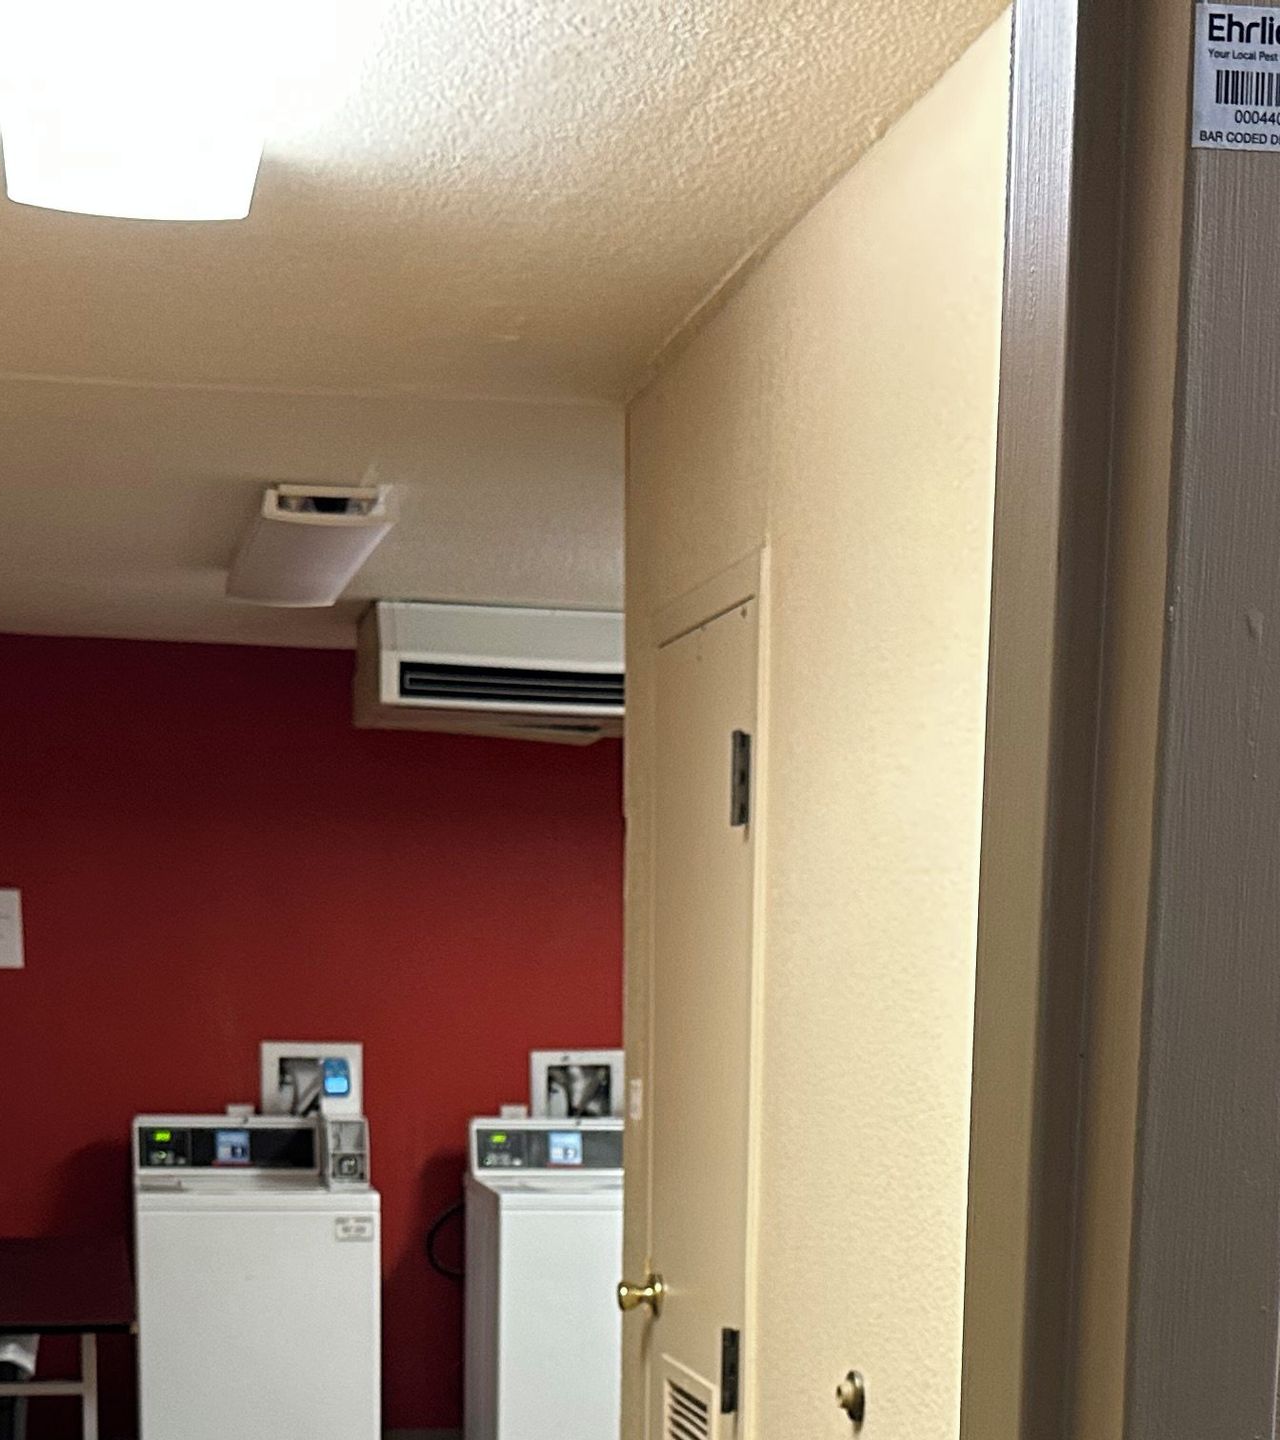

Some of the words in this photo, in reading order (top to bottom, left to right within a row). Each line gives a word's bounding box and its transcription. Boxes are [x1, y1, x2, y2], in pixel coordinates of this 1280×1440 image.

[1208, 48, 1230, 59] Your
[1232, 51, 1256, 60] Local
[1259, 52, 1278, 62] Pest
[1200, 131, 1223, 142] BAR
[1227, 132, 1267, 144] CODED
